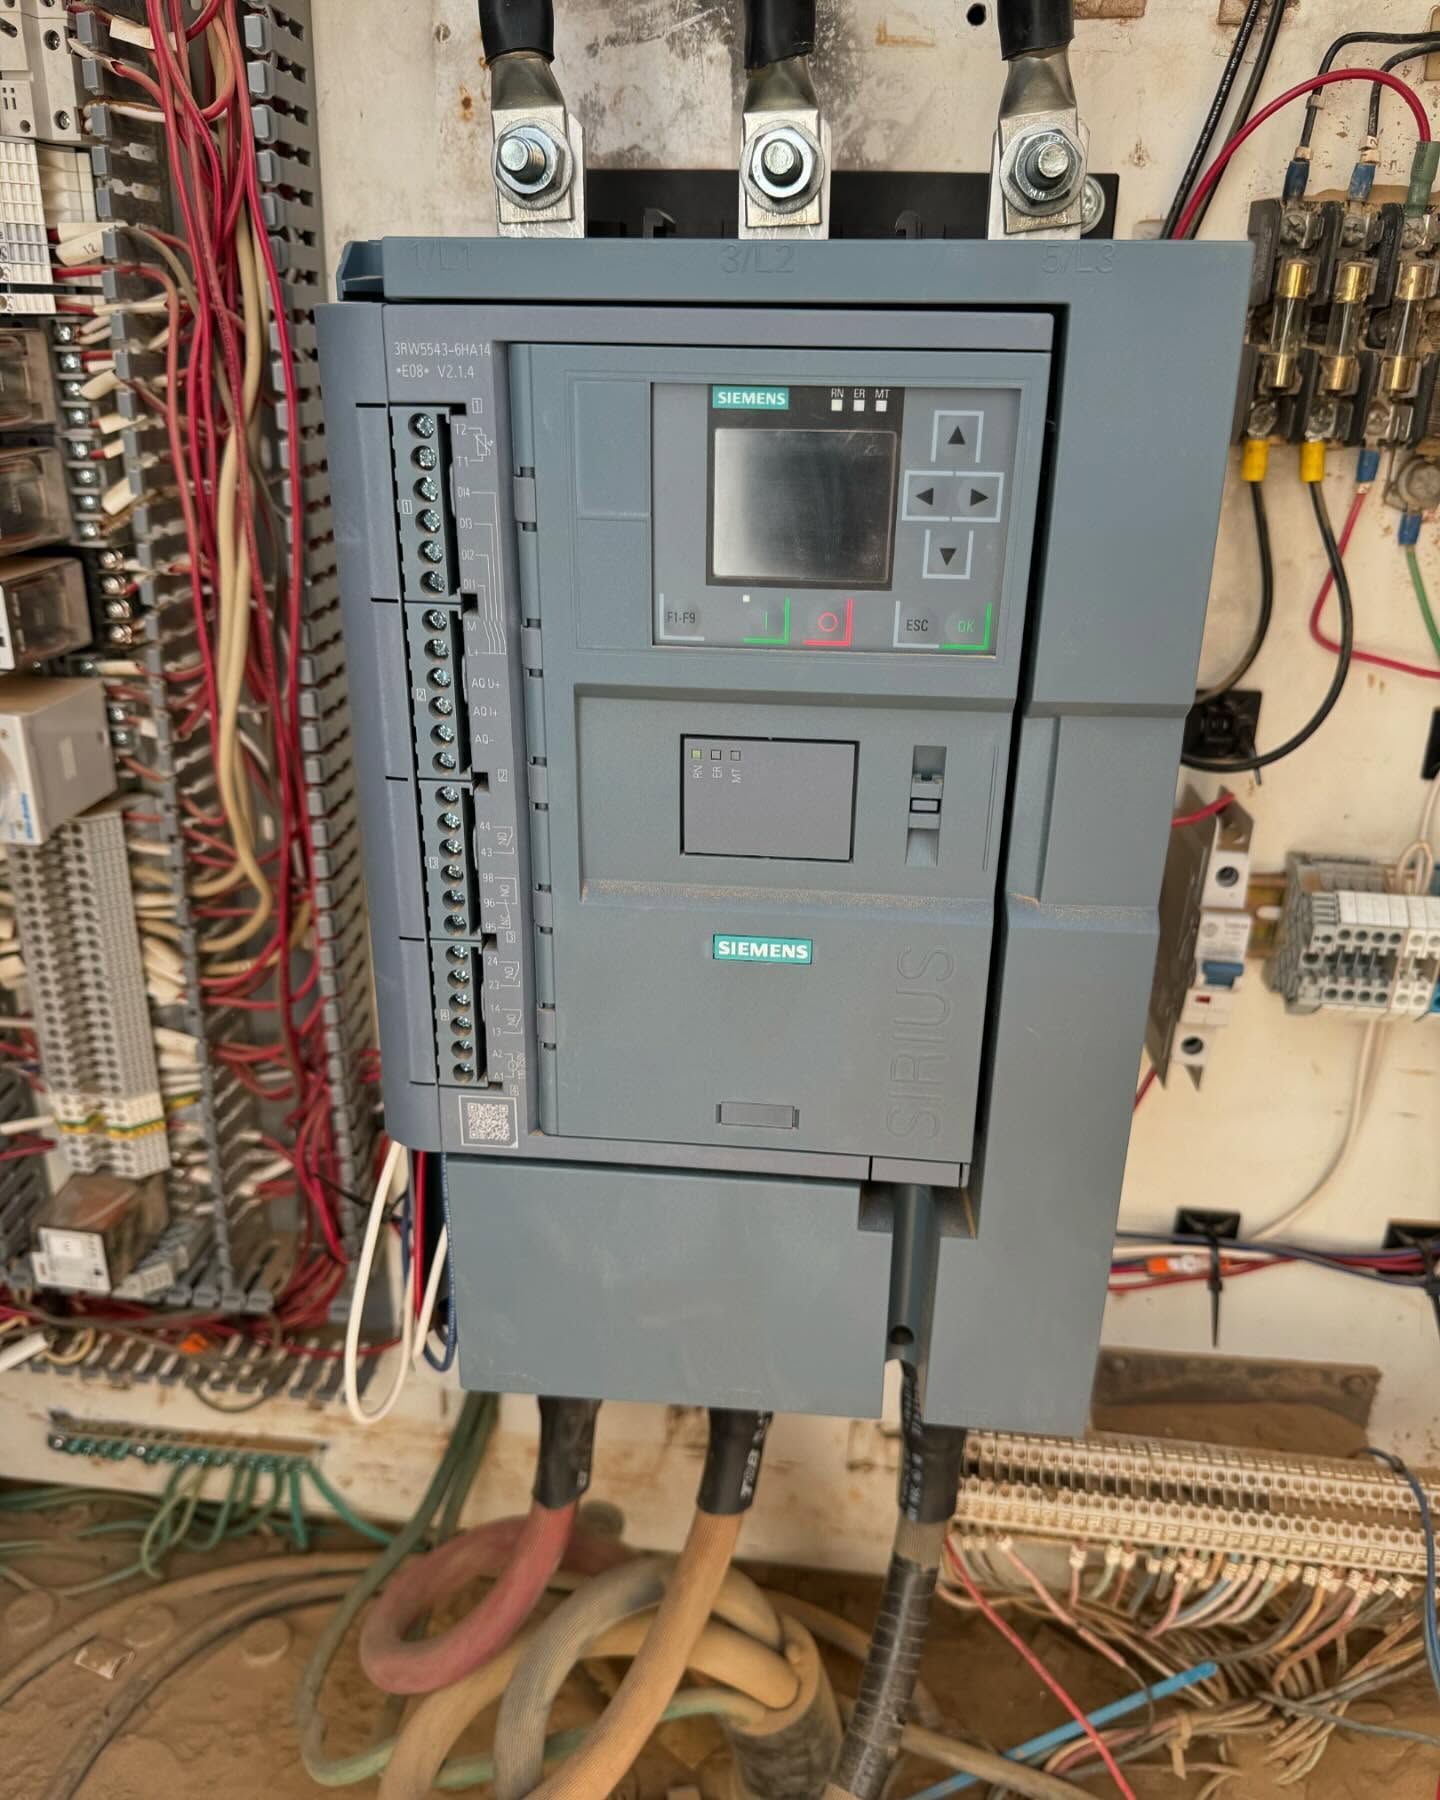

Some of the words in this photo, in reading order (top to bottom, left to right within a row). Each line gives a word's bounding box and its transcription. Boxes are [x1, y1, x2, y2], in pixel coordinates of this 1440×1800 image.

[720, 244, 795, 274] 3/L2
[1040, 245, 1115, 274] 5/L3
[393, 342, 491, 357] 3RW5543-6HA14
[437, 365, 474, 378] V2.1.4
[717, 391, 787, 406] SIEMENS
[831, 388, 844, 399] RN
[854, 388, 865, 399] ER
[875, 388, 890, 399] MT
[455, 424, 466, 436] T2
[456, 456, 469, 467] T1
[457, 487, 471, 497] DI4
[460, 518, 472, 528] DI3
[462, 550, 474, 560] DI2
[463, 581, 476, 590] DI1
[667, 611, 696, 625] F1-F9
[467, 622, 476, 631] M
[906, 619, 928, 632] ESC
[958, 621, 974, 633] OK
[480, 821, 491, 831] 44
[481, 848, 492, 857] 43
[484, 898, 495, 907] 96
[718, 940, 808, 959] SIEMENS
[887, 944, 954, 1139] SIRIUS
[492, 1049, 503, 1058] A2
